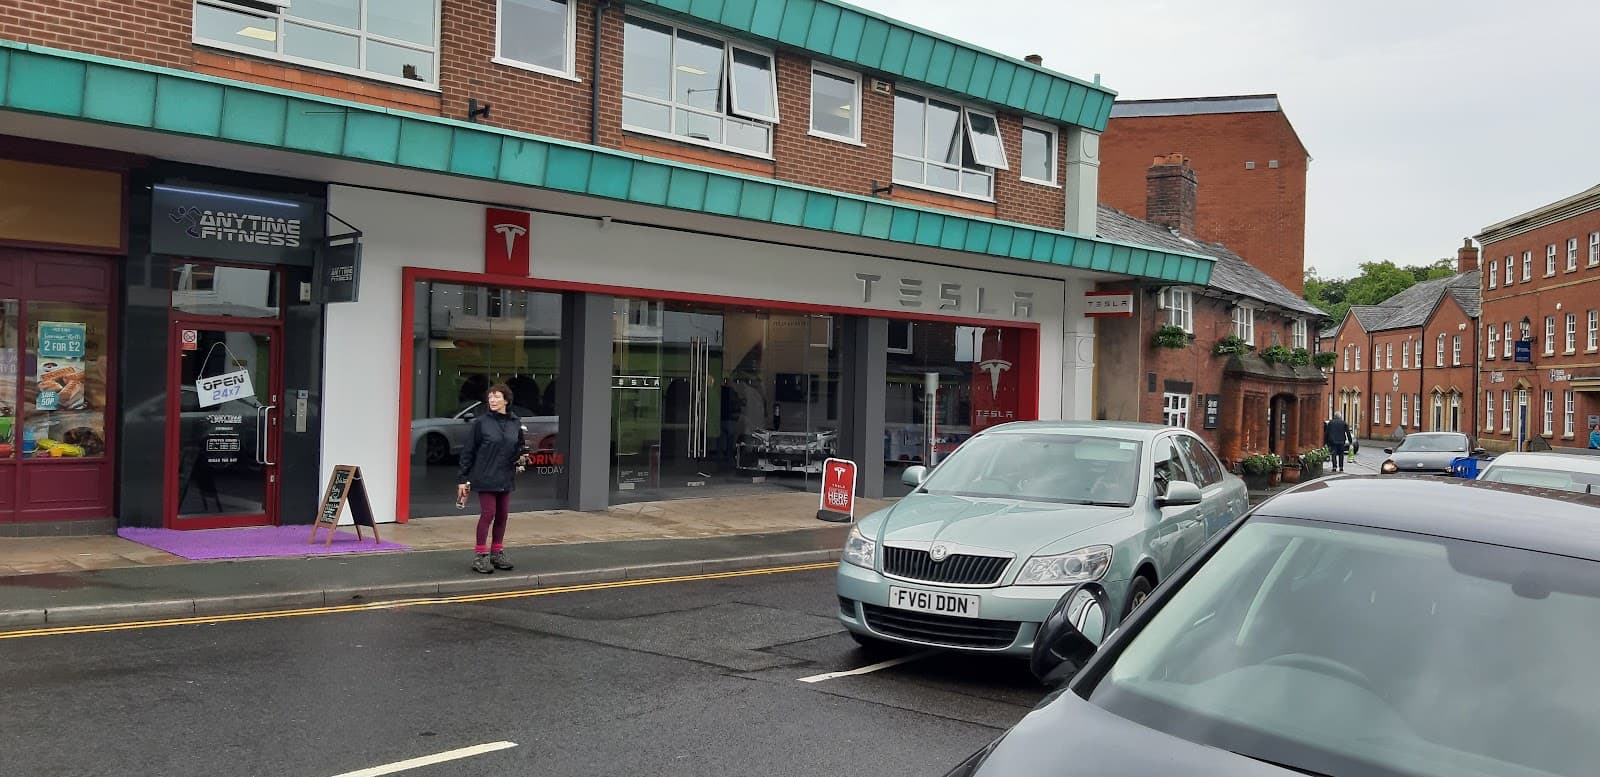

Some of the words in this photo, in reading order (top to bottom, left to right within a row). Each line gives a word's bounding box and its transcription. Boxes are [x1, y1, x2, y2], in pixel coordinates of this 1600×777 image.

[199, 210, 301, 236] ANYTIME
[201, 226, 301, 249] FITNESS
[855, 272, 1034, 318] TESLA
[1087, 300, 1127, 308] TESLA
[44, 341, 50, 351] 2
[52, 343, 67, 351] FOR
[68, 341, 81, 352] £2
[203, 374, 245, 391] OPEN
[41, 391, 55, 399] SAVE
[976, 409, 1014, 419] TESLA
[535, 466, 565, 475] TODAY
[828, 491, 849, 502] HERE
[828, 498, 848, 508] TODAY
[898, 590, 931, 609] FV61
[935, 595, 967, 613] DDN
